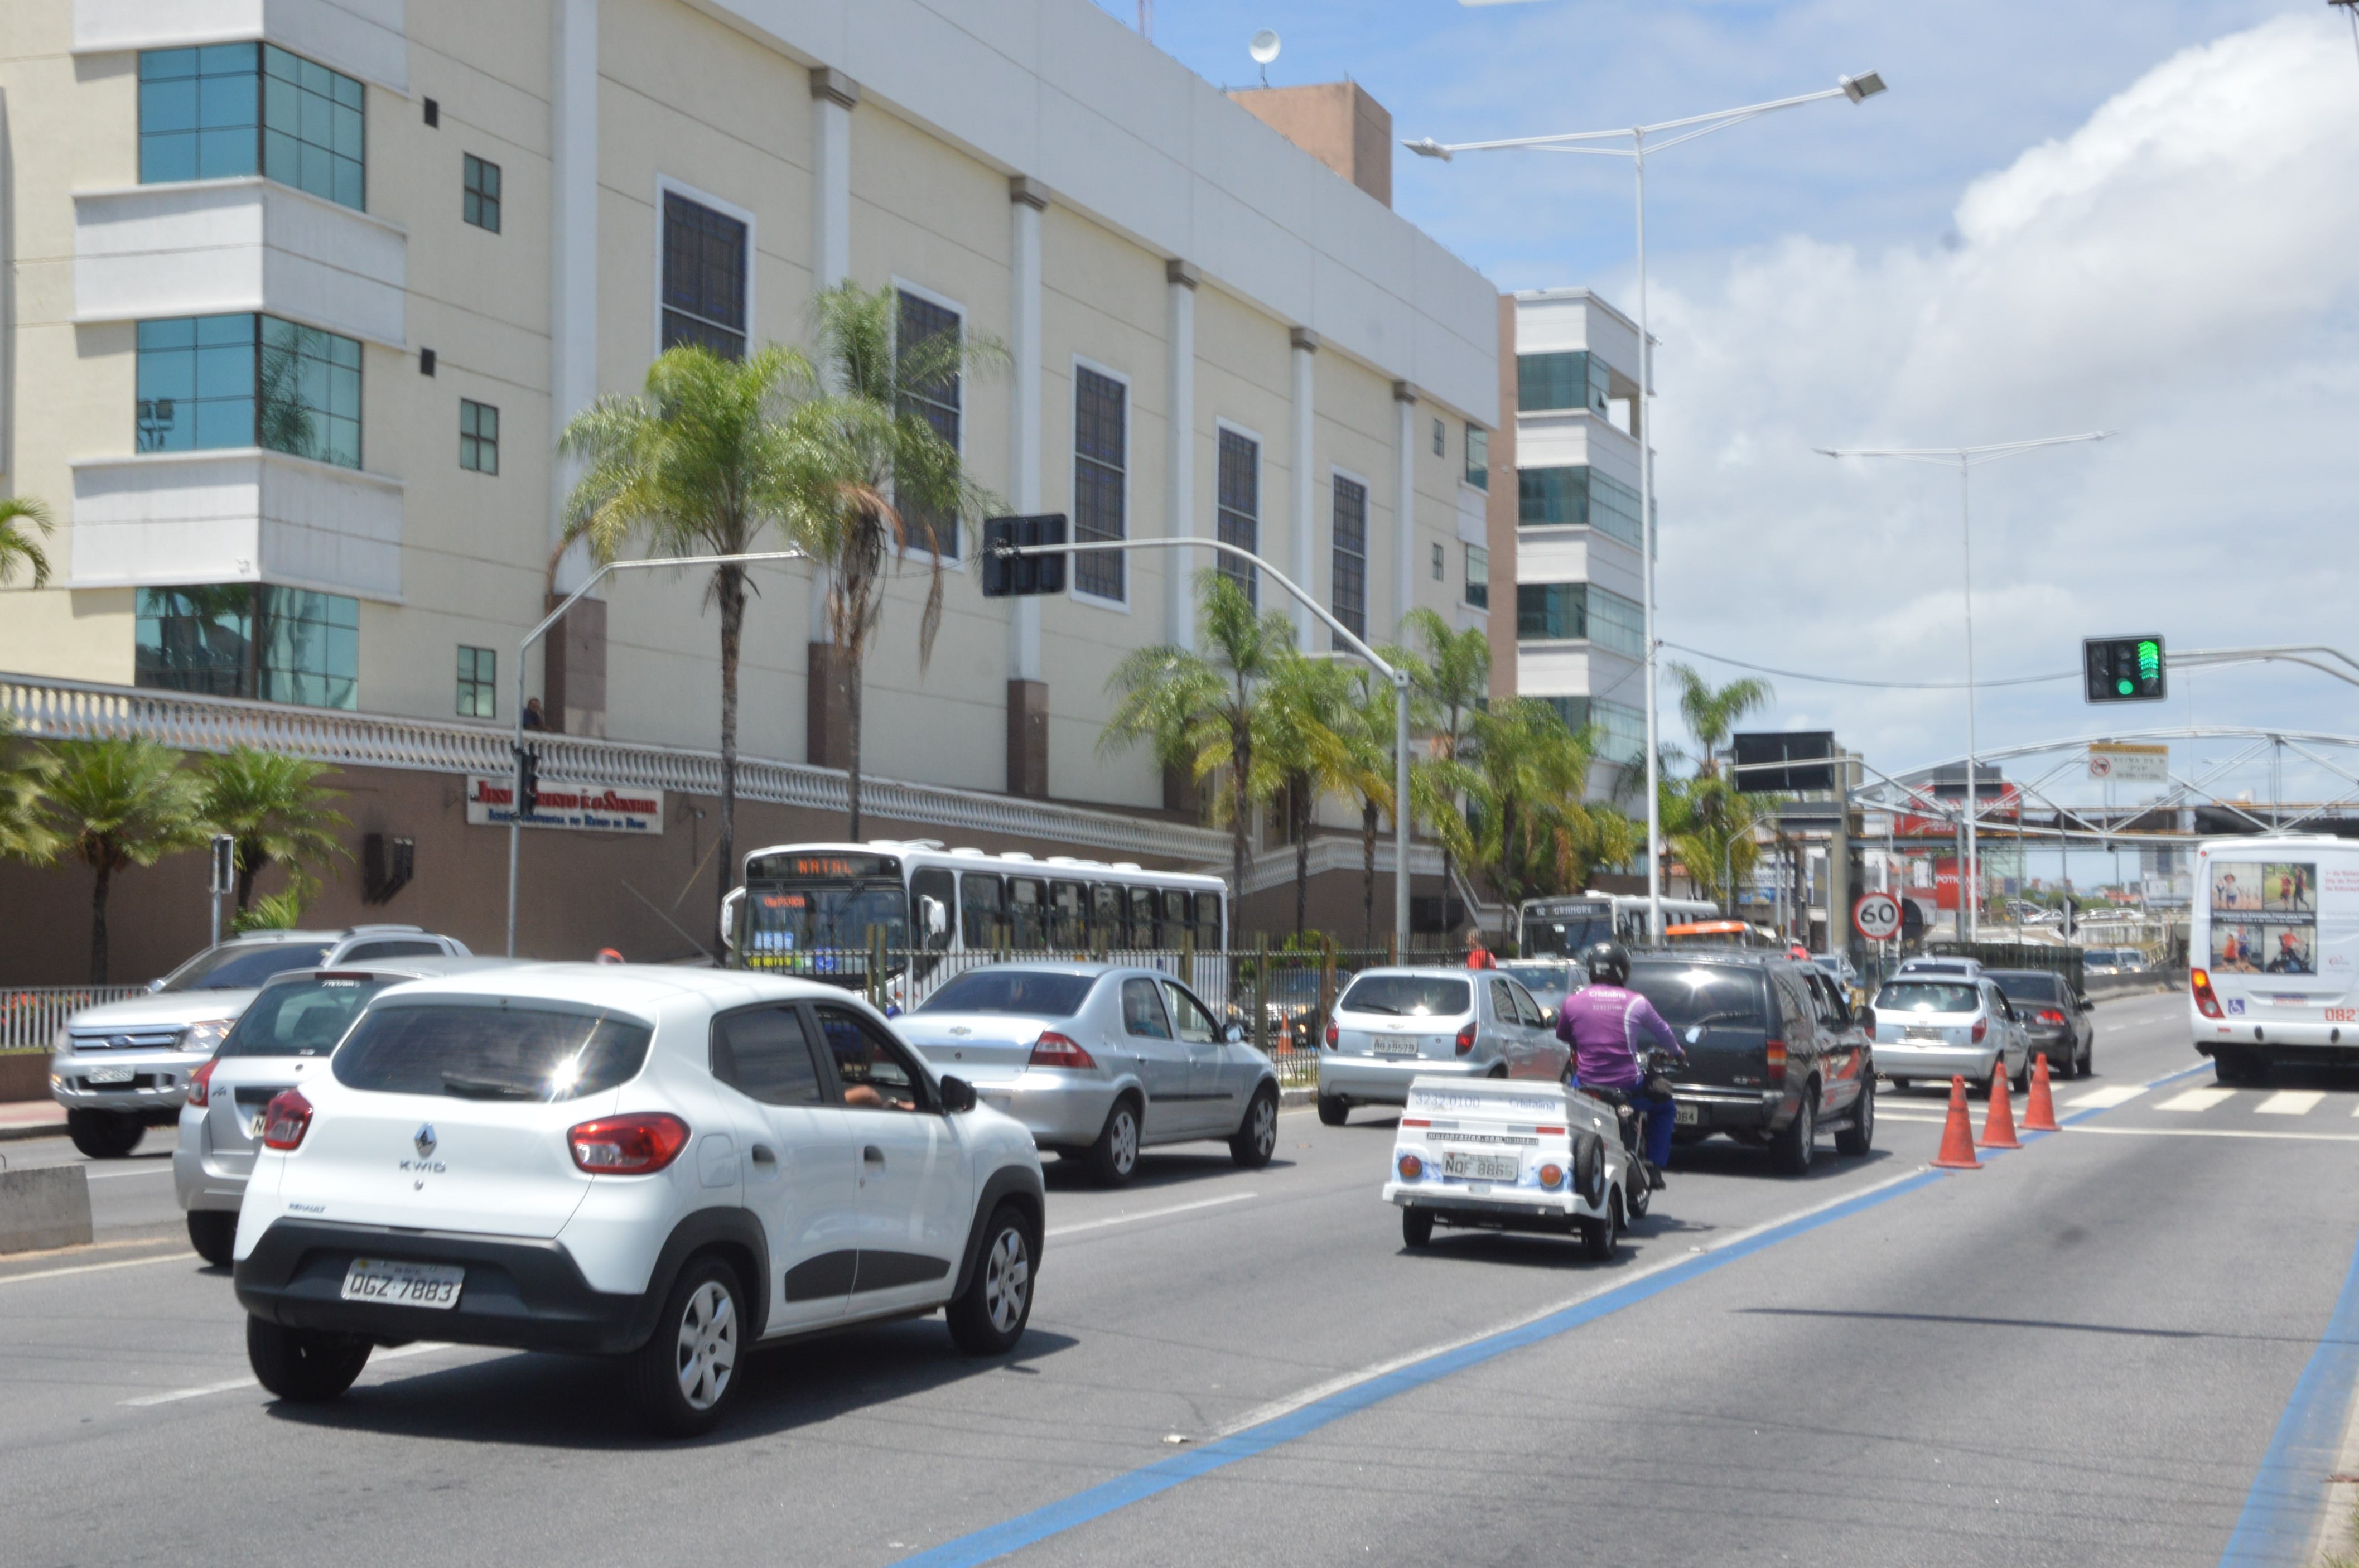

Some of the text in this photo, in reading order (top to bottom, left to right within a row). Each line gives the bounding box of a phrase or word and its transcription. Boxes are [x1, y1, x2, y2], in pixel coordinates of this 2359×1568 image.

[798, 859, 852, 875] NATAL
[1861, 904, 1896, 924] 60
[1589, 990, 1627, 1000] Cristalina
[2324, 1007, 2359, 1022] 082
[1509, 1097, 1556, 1110] Cristalina
[400, 1160, 446, 1173] KWID
[288, 1203, 326, 1213] RENAULT
